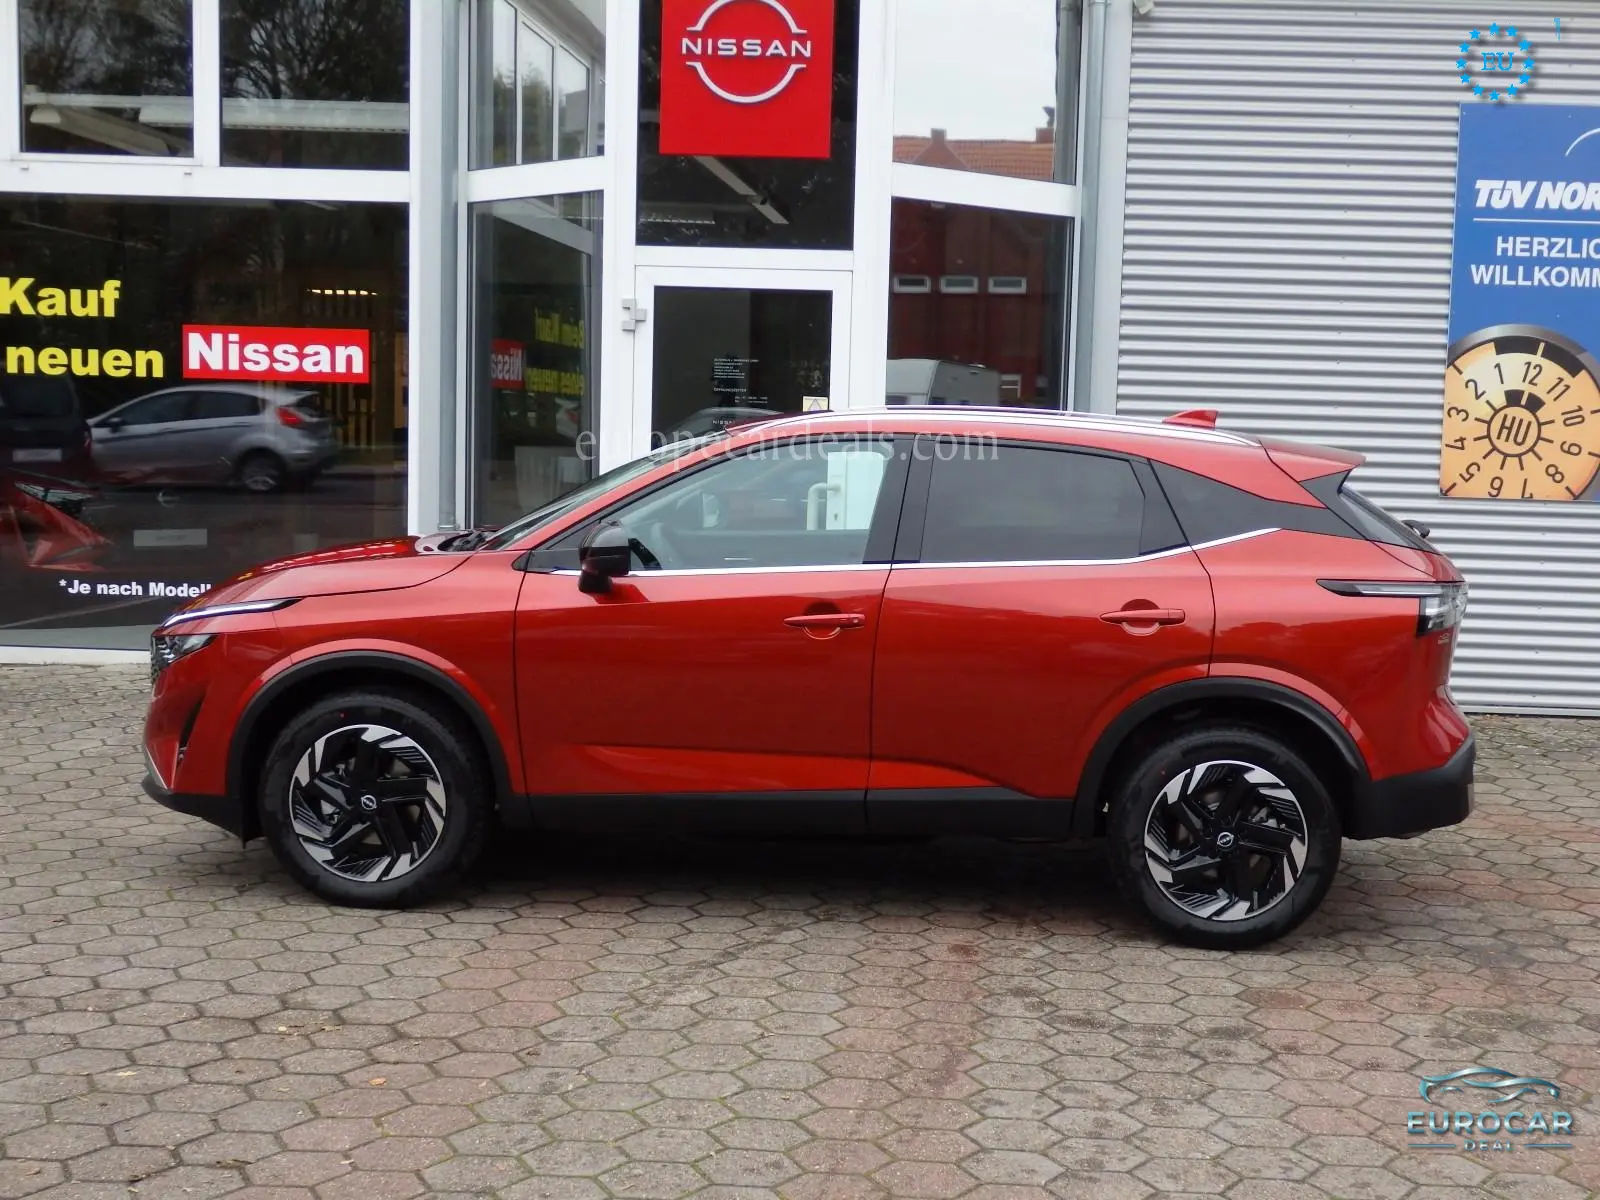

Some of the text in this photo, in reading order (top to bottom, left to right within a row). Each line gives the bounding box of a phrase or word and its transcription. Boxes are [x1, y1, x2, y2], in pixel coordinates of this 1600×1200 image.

[681, 37, 812, 58] NISSAN
[1535, 181, 1600, 210] NOR
[0, 276, 121, 317] Kauf
[6, 332, 364, 378] neuen Nissan
[1494, 362, 1505, 385] 1
[1522, 361, 1543, 387] 12
[1465, 378, 1486, 401] 2
[1546, 377, 1571, 402] 11
[1447, 405, 1470, 423] 3
[1560, 405, 1586, 427] 10
[1496, 413, 1532, 446] HU
[1445, 436, 1467, 452] 4
[1559, 440, 1583, 457] 9
[1458, 461, 1481, 483] 5
[1545, 463, 1565, 484] 8
[1488, 476, 1504, 498] 6
[97, 581, 142, 596] nach
